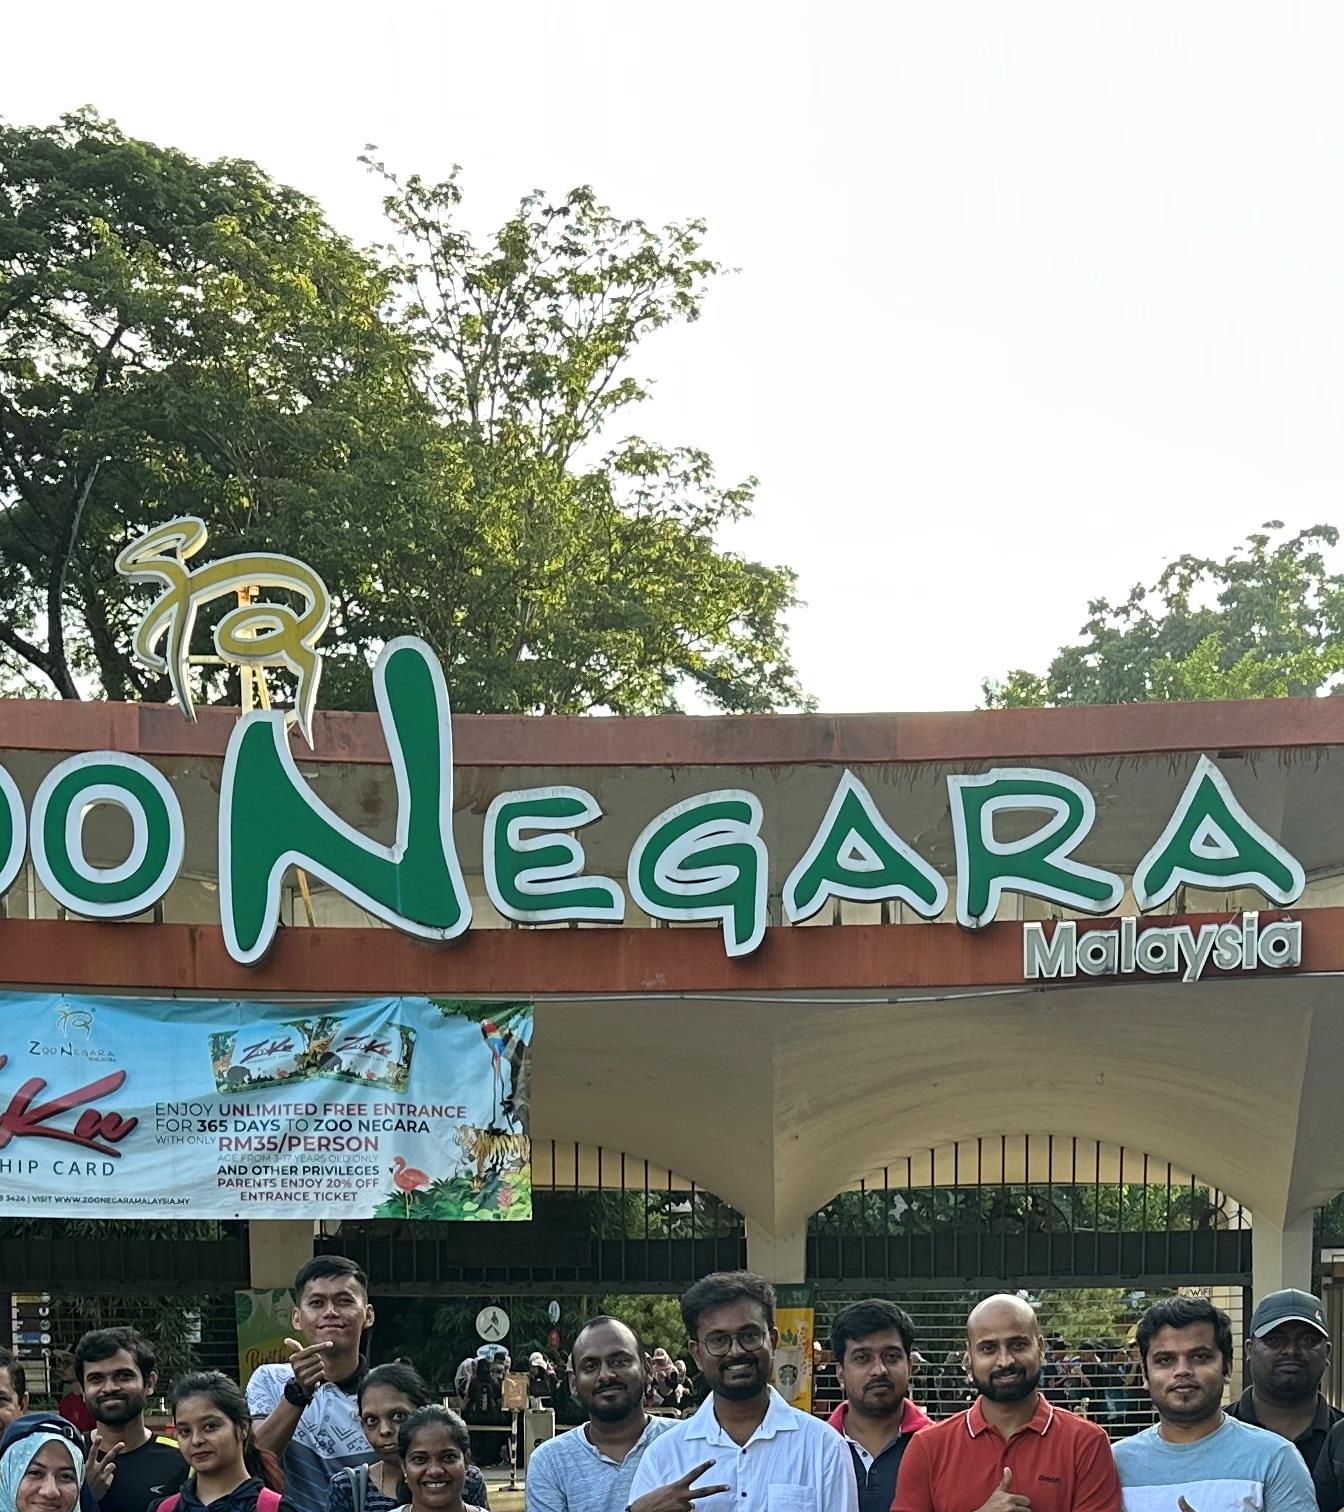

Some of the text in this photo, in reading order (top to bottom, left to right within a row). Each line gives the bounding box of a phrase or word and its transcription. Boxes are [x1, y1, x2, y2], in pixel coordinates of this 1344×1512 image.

[1023, 911, 1303, 983] Malaysia
[156, 1102, 467, 1119] ENJOY UNLIMITED FREE ENTRANCE
[156, 1118, 430, 1134] FOR 365 DAYS TO ZOO NEGARA
[155, 1133, 379, 1154] WITH ONLY RM35/PERSON
[217, 1154, 238, 1163] AGE
[241, 1154, 271, 1163] FROM
[294, 1154, 326, 1163] YEARS
[328, 1154, 350, 1163] OLD
[352, 1154, 379, 1164] ONLY
[52, 1160, 115, 1177] CARD
[217, 1165, 380, 1176] AND OTHER PRIVILEGES
[217, 1178, 380, 1189] PARENTS ENJOY 20% OFF
[32, 1195, 53, 1203] VISIT
[240, 1191, 359, 1202] ENTRANCE TICKET
